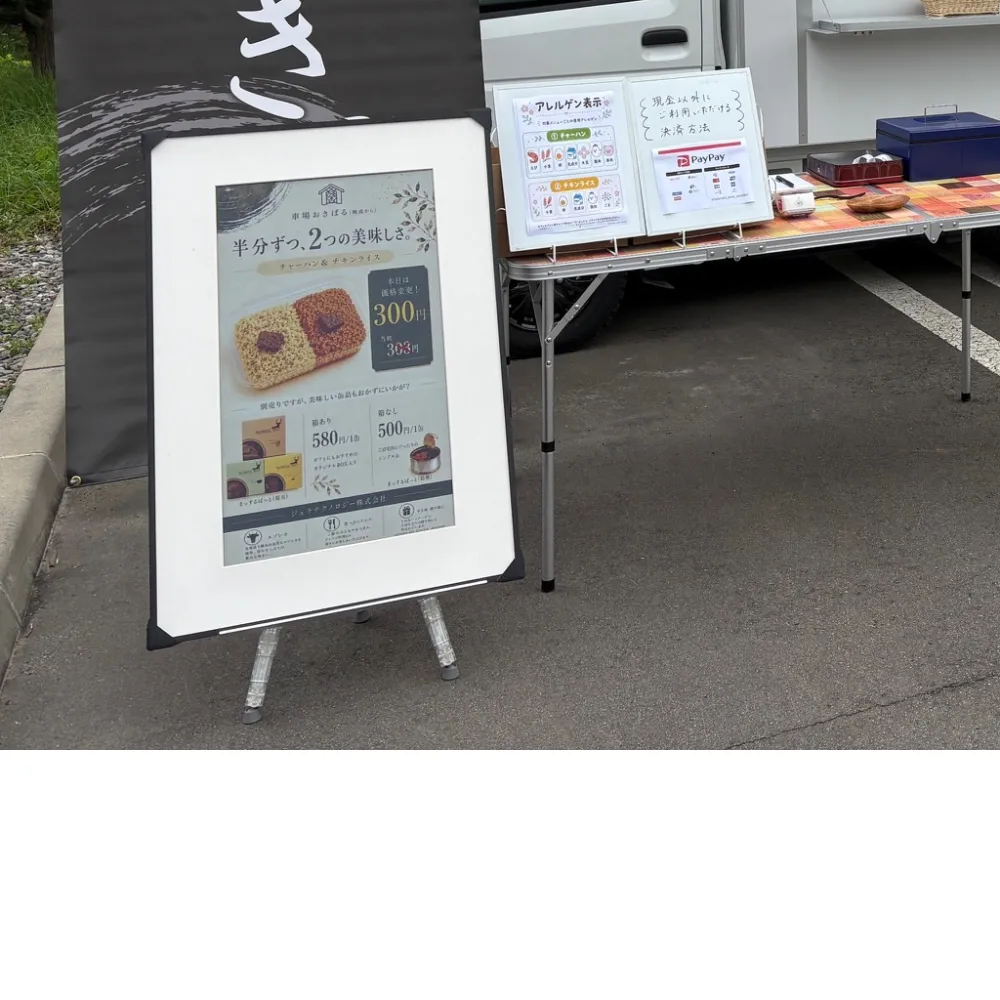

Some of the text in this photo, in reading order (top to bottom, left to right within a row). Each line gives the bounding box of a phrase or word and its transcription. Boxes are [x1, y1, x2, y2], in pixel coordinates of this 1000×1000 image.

[535, 97, 602, 112] アレルゲン表示
[652, 91, 711, 107] 現金以外に
[659, 104, 731, 119] ご利用いただける
[660, 123, 711, 138] 決済方法
[691, 153, 725, 164] PayPay
[563, 180, 595, 188] チキンライス
[232, 226, 411, 257] 半分ずつ、2つの美味しさ。
[373, 300, 426, 326] 300円
